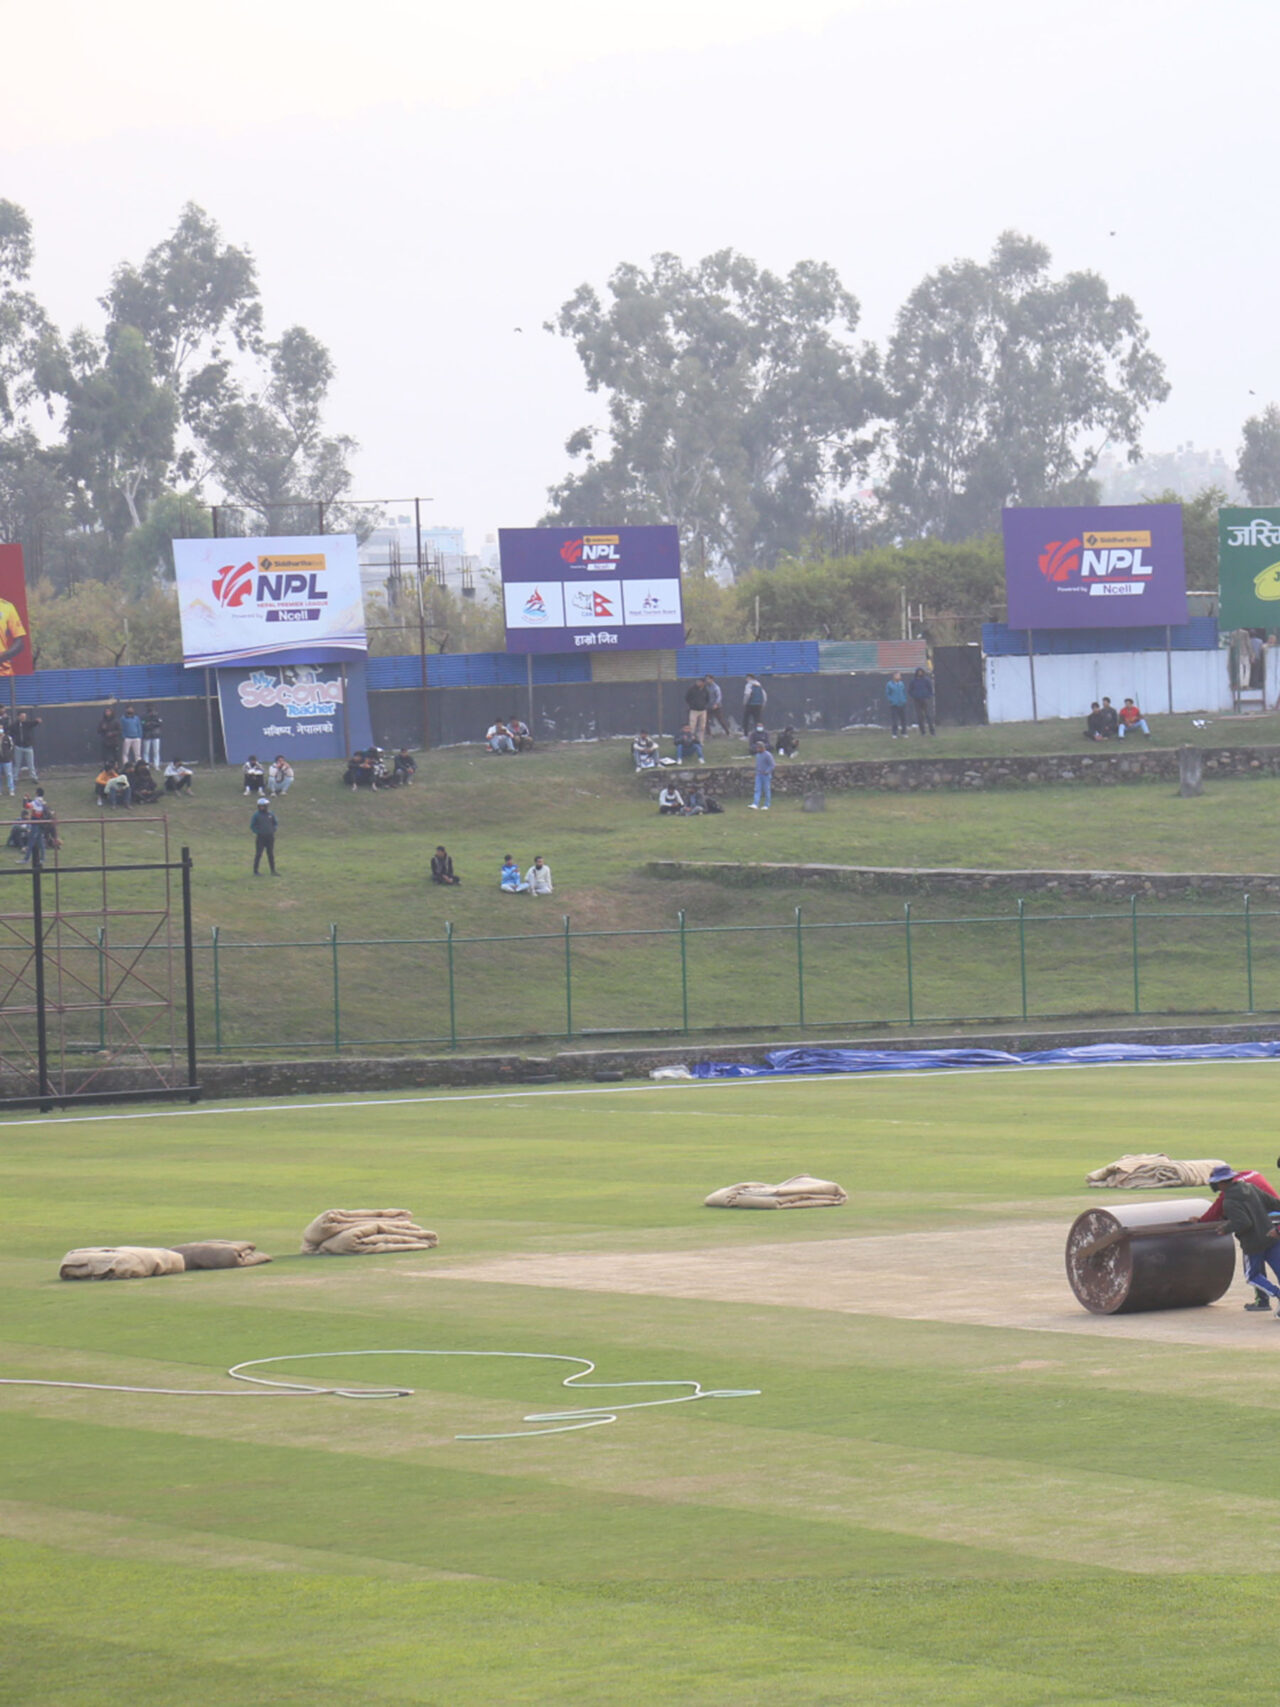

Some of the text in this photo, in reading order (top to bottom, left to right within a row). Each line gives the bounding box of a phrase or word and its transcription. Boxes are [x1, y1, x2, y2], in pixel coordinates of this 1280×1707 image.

[582, 545, 620, 560] NPL
[1081, 549, 1153, 576] NPL
[256, 573, 328, 601] NPL
[1103, 584, 1132, 594] Ncell
[278, 610, 309, 621] Ncell
[249, 670, 276, 690] My
[238, 677, 345, 708] Second
[286, 703, 335, 717] Teacher
